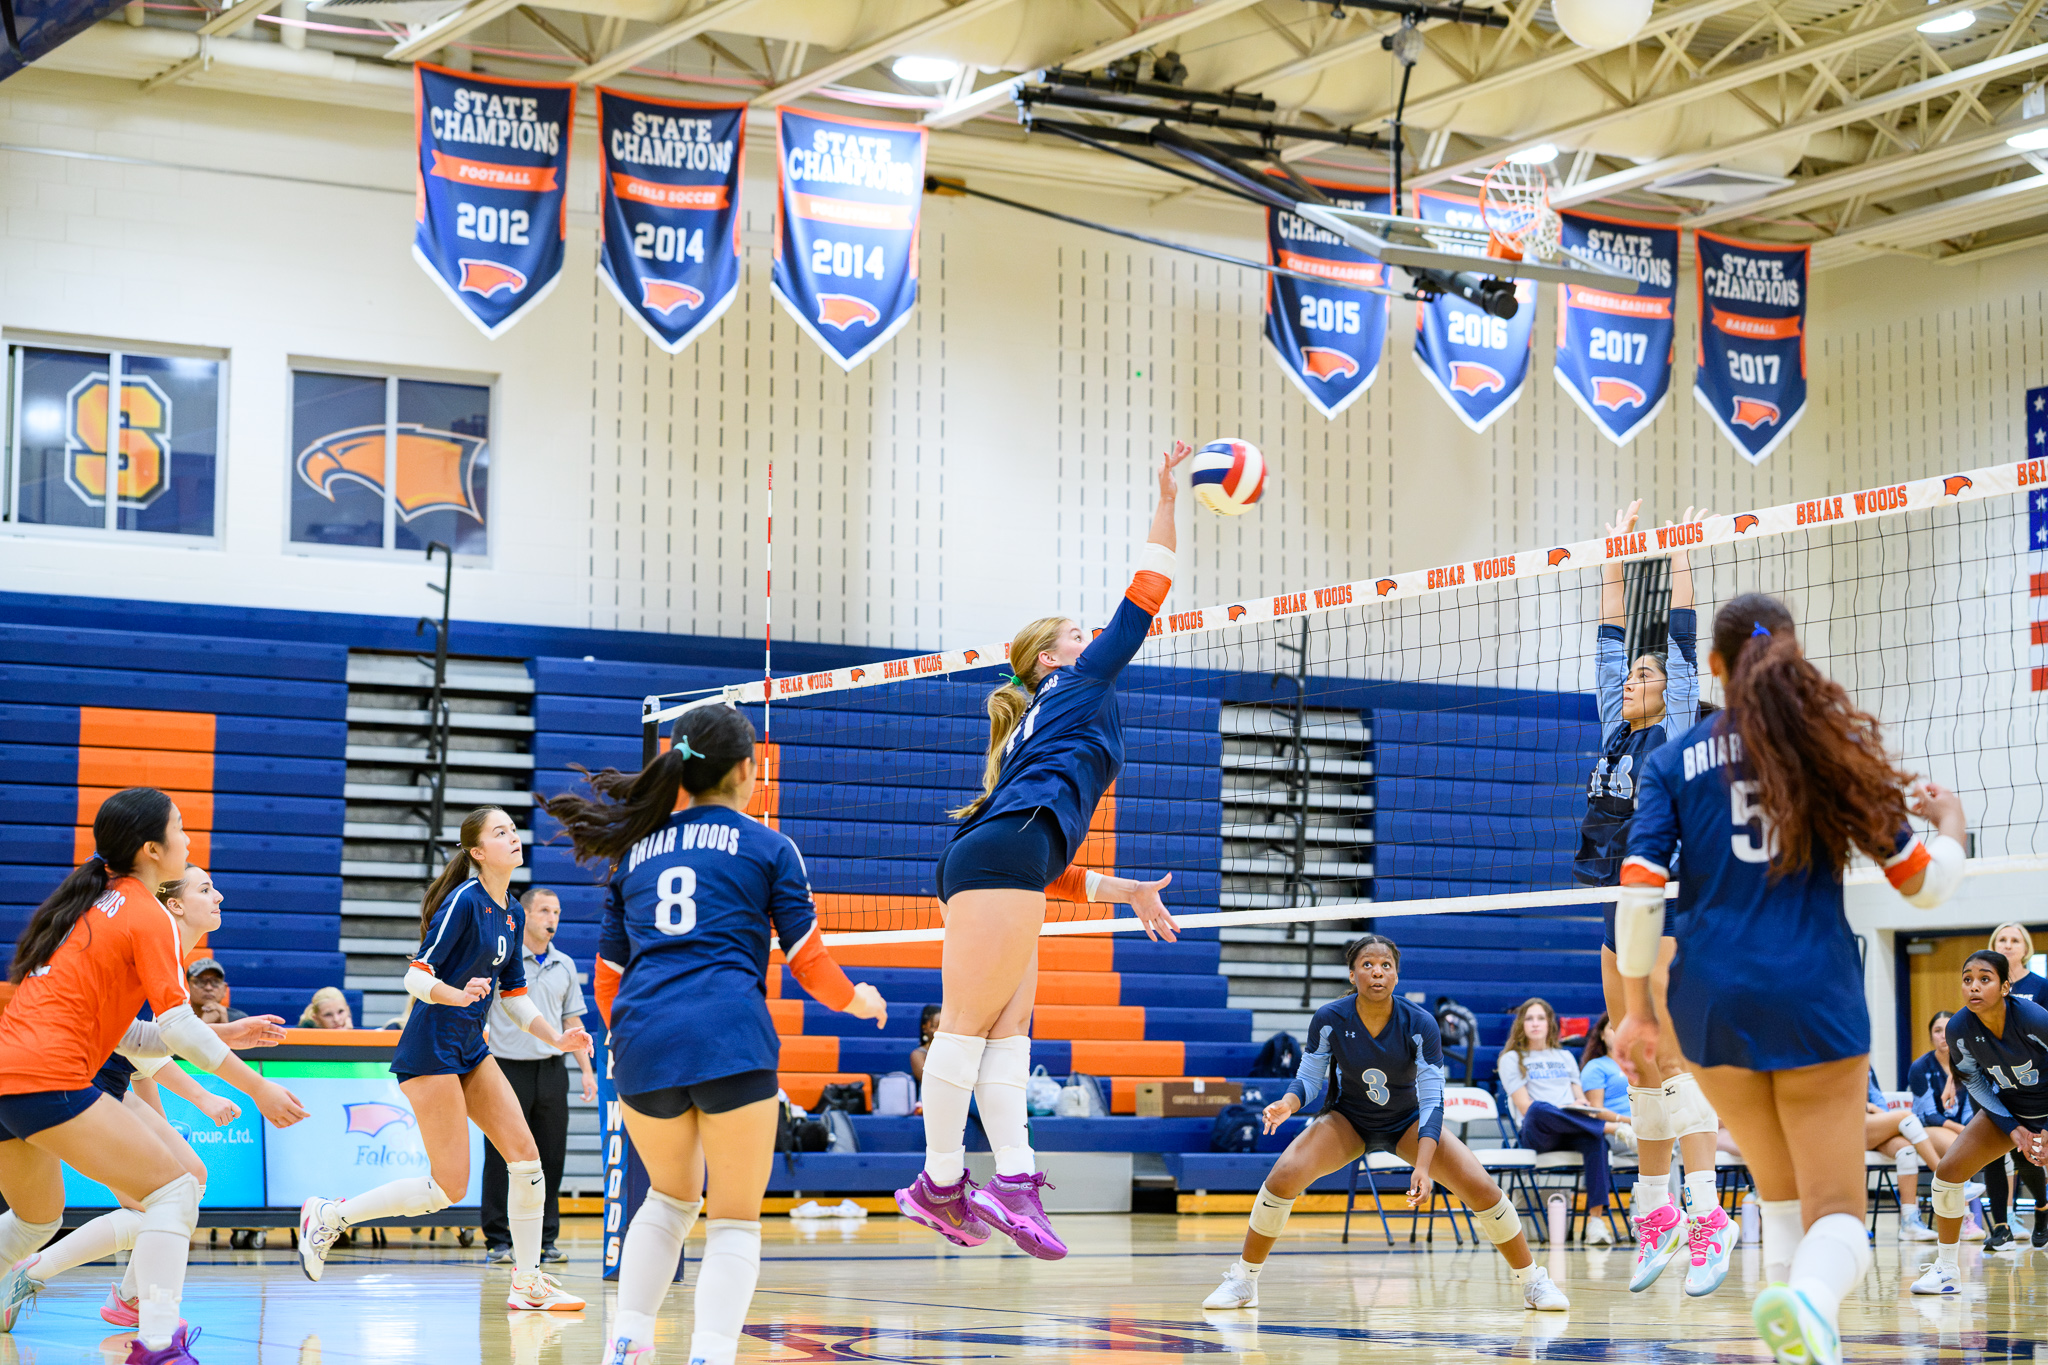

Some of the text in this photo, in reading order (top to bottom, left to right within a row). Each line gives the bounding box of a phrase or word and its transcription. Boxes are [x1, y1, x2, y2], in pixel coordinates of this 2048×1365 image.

[453, 88, 537, 122] STATE
[429, 106, 560, 156] CHAMPIONS
[632, 111, 712, 143] STATE
[611, 128, 734, 175] CHAMPIONS
[812, 129, 892, 163] STATE
[458, 164, 532, 186] FOOTBALL
[788, 146, 914, 196] CHAMPIONS
[627, 182, 717, 206] GIRLS SOCCER
[456, 202, 530, 246] 2012
[633, 221, 705, 264] 2014
[811, 238, 885, 281] 2014
[1587, 228, 1653, 258] STATE
[1721, 253, 1784, 280] STATE
[1704, 267, 1800, 307] CHAMPIONS
[1299, 294, 1361, 335] 2015
[1447, 310, 1508, 350] 2016
[1588, 327, 1648, 366] 2017
[1727, 349, 1781, 385] 2017
[2017, 459, 2048, 487] BRI
[1796, 485, 1908, 525] BRIAR WOODS
[1605, 521, 1704, 559] BRIAR WOODS
[1427, 555, 1516, 590] BRIAR WOODS
[1273, 584, 1352, 616] BRIAR WOODS
[1168, 610, 1204, 633] WOODS
[779, 672, 833, 694] BRIAR WOODS
[883, 654, 942, 679] BRIAR WOODS
[1731, 779, 1781, 863] 5
[682, 823, 740, 856] WOODS
[654, 866, 697, 936] 8
[492, 935, 507, 966] 9
[1361, 1067, 1391, 1106] 3
[1986, 1058, 2040, 1090] 15
[605, 1100, 623, 1267] WOODS
